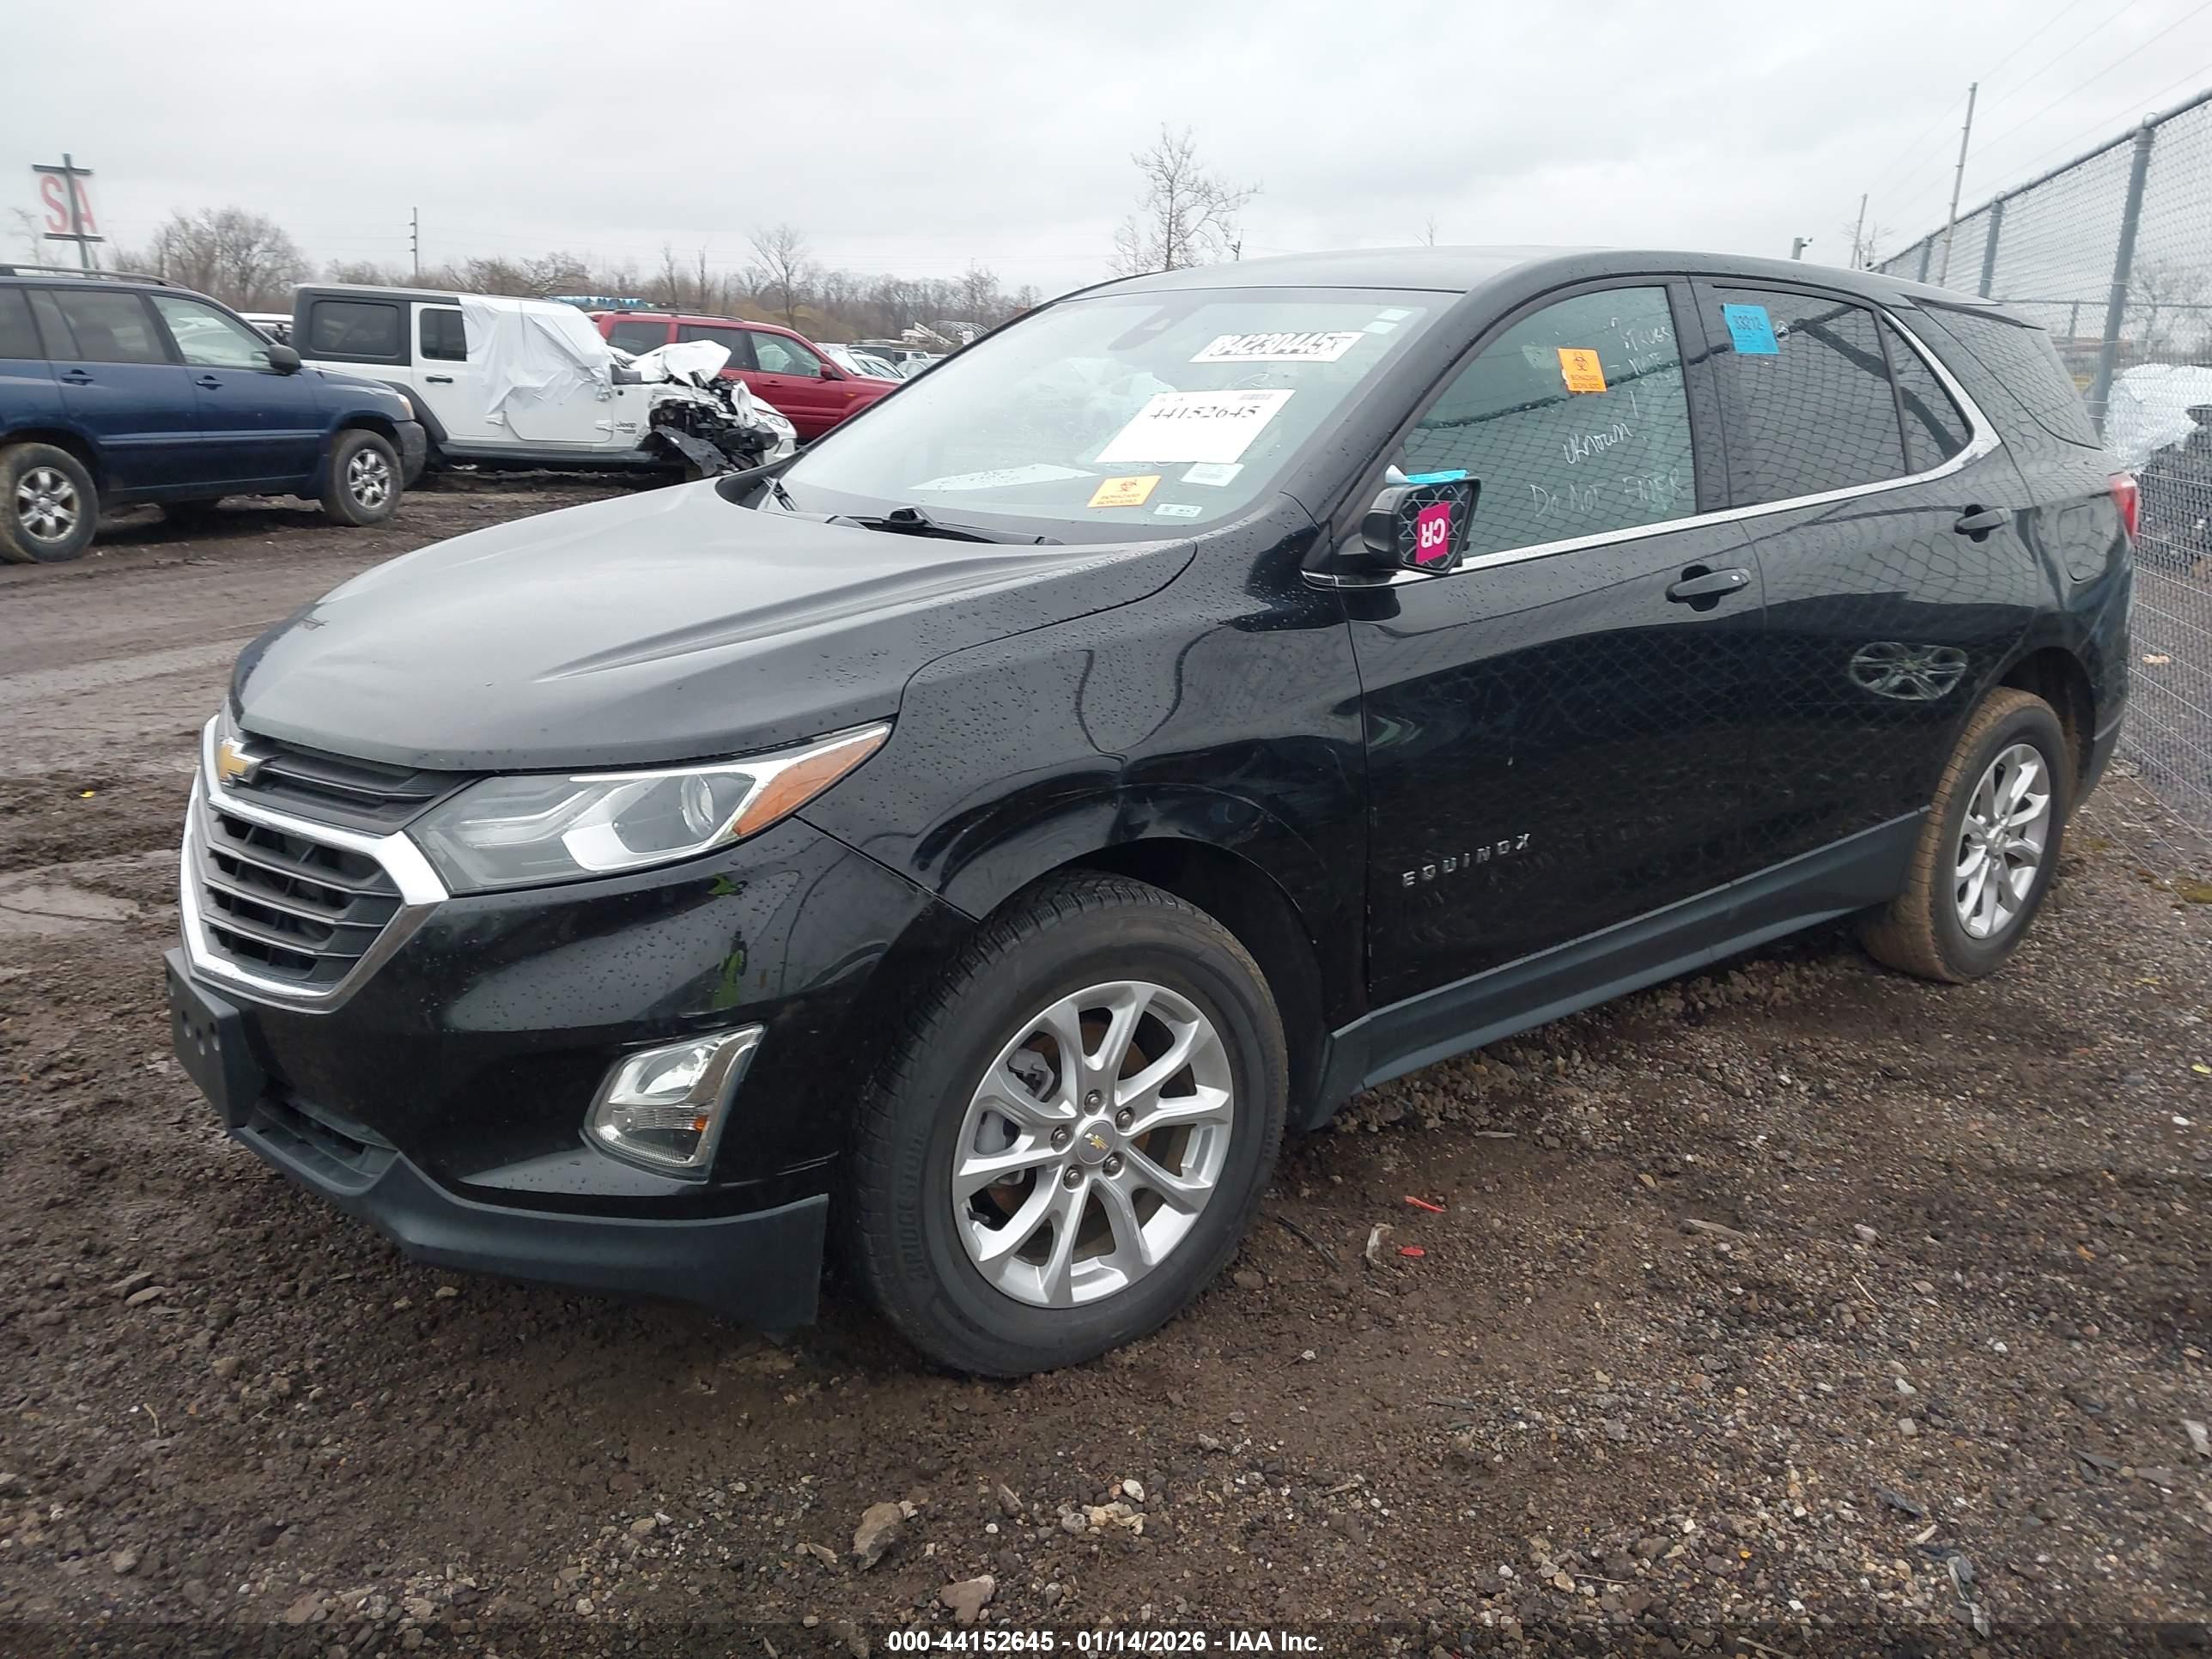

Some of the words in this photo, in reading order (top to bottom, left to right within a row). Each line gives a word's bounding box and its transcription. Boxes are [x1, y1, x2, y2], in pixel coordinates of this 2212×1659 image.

[1148, 406, 1261, 420] 44152645
[1420, 518, 1446, 548] CR
[1401, 833, 1532, 888] EQUINOX
